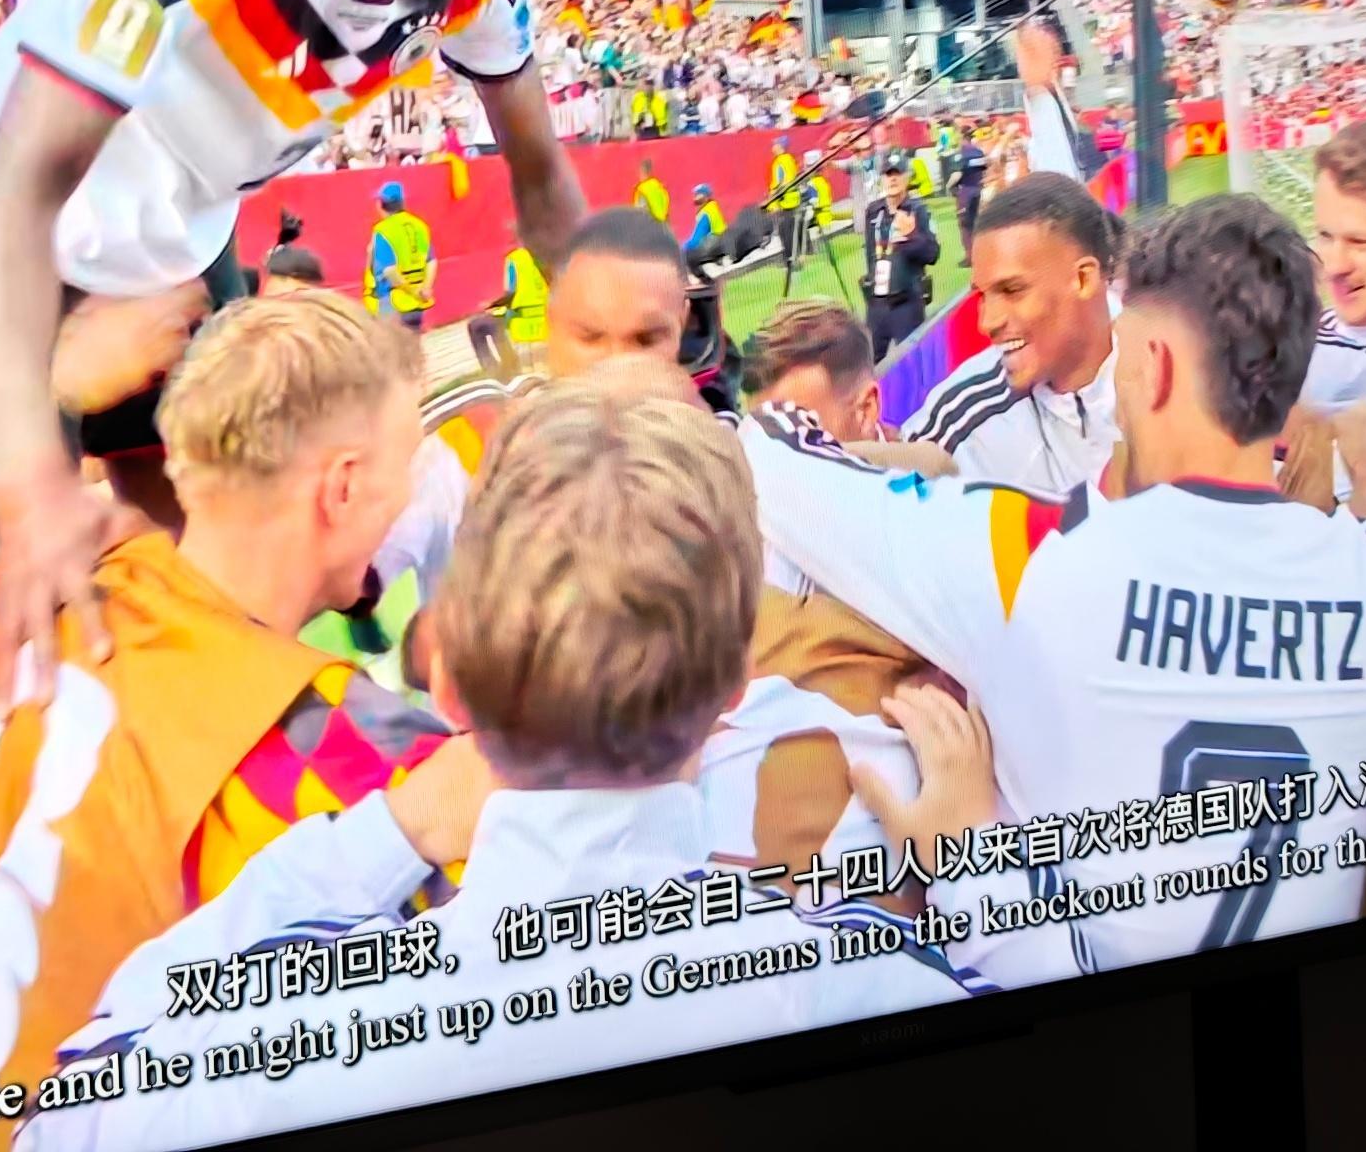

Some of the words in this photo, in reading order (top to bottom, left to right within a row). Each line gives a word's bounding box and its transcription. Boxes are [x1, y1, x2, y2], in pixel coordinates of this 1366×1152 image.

[1116, 579, 1363, 681] HAVERTZ
[38, 1054, 123, 1109] and
[137, 1048, 190, 1092] he
[205, 1020, 335, 1080] might
[342, 1003, 425, 1065] just
[439, 997, 493, 1042] up
[503, 985, 557, 1024] on
[568, 967, 632, 1011] the
[642, 936, 817, 996] Germans
[830, 921, 902, 964] into
[913, 905, 969, 945] the
[980, 872, 1144, 935] knockout
[1154, 849, 1268, 902] rounds
[1278, 840, 1327, 878] for
